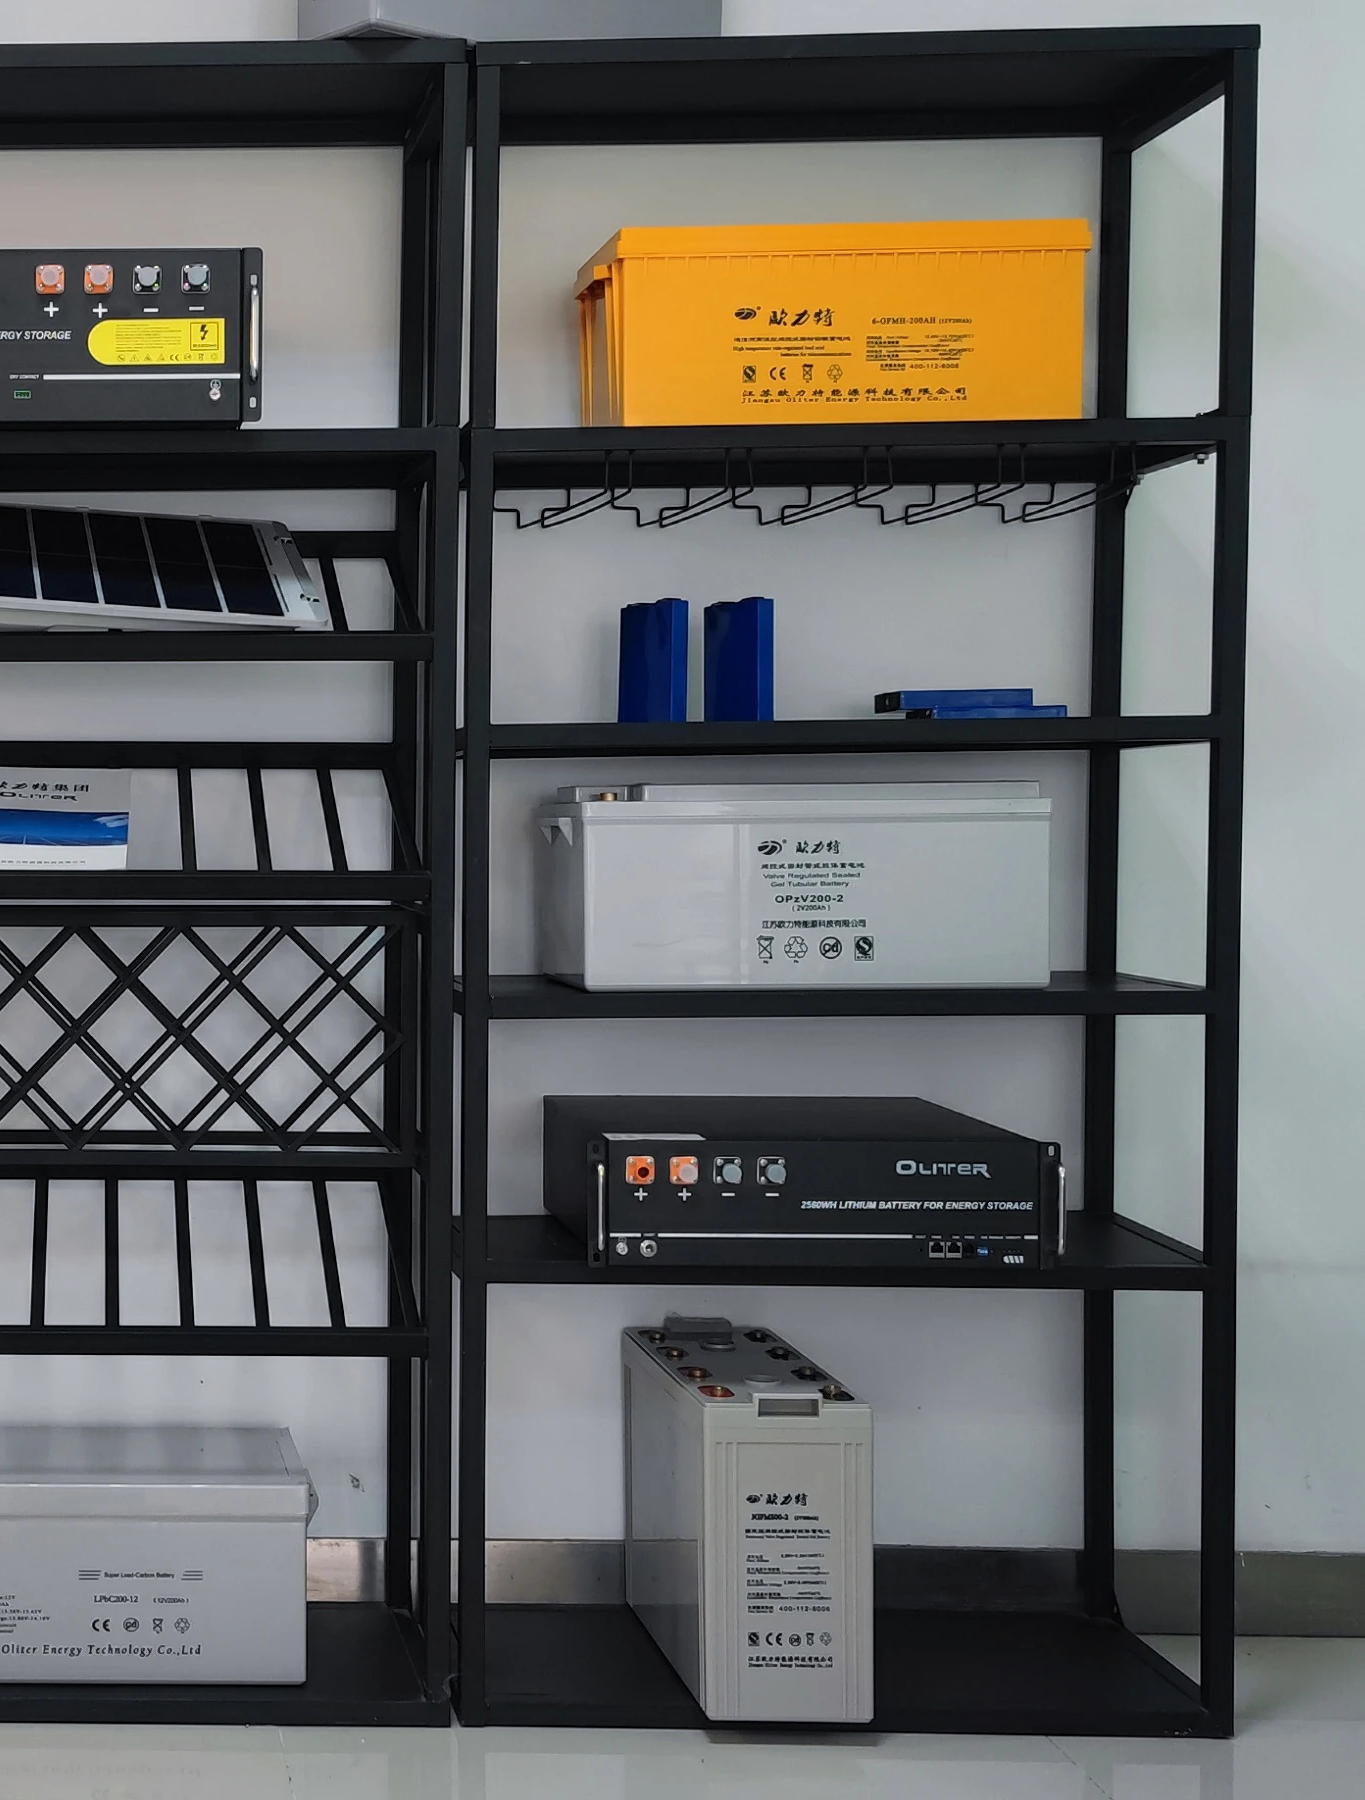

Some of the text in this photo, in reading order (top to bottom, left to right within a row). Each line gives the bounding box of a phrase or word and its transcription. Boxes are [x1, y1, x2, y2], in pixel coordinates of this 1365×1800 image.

[768, 307, 835, 327] 欧力特
[23, 330, 72, 341] STORAGE
[795, 839, 841, 855] 欧力特
[763, 871, 861, 880] Valve Regulated Sealed
[819, 880, 850, 888] Battery
[774, 893, 845, 904] OPzV200-2
[761, 918, 867, 930] 江苏欧力特能源科技有限公司
[838, 1200, 877, 1210] LITHIUM
[878, 1201, 922, 1210] BATTERY
[922, 1201, 944, 1210] FOR
[945, 1201, 986, 1210] ENERGY
[986, 1201, 1034, 1211] STORAGE
[765, 1492, 808, 1507] 欧力特
[155, 1571, 175, 1579] Battery
[1, 1643, 38, 1655] Oliter
[42, 1644, 83, 1658] Energy
[87, 1643, 153, 1658] Technology
[157, 1644, 202, 1656] Co.,Ltd
